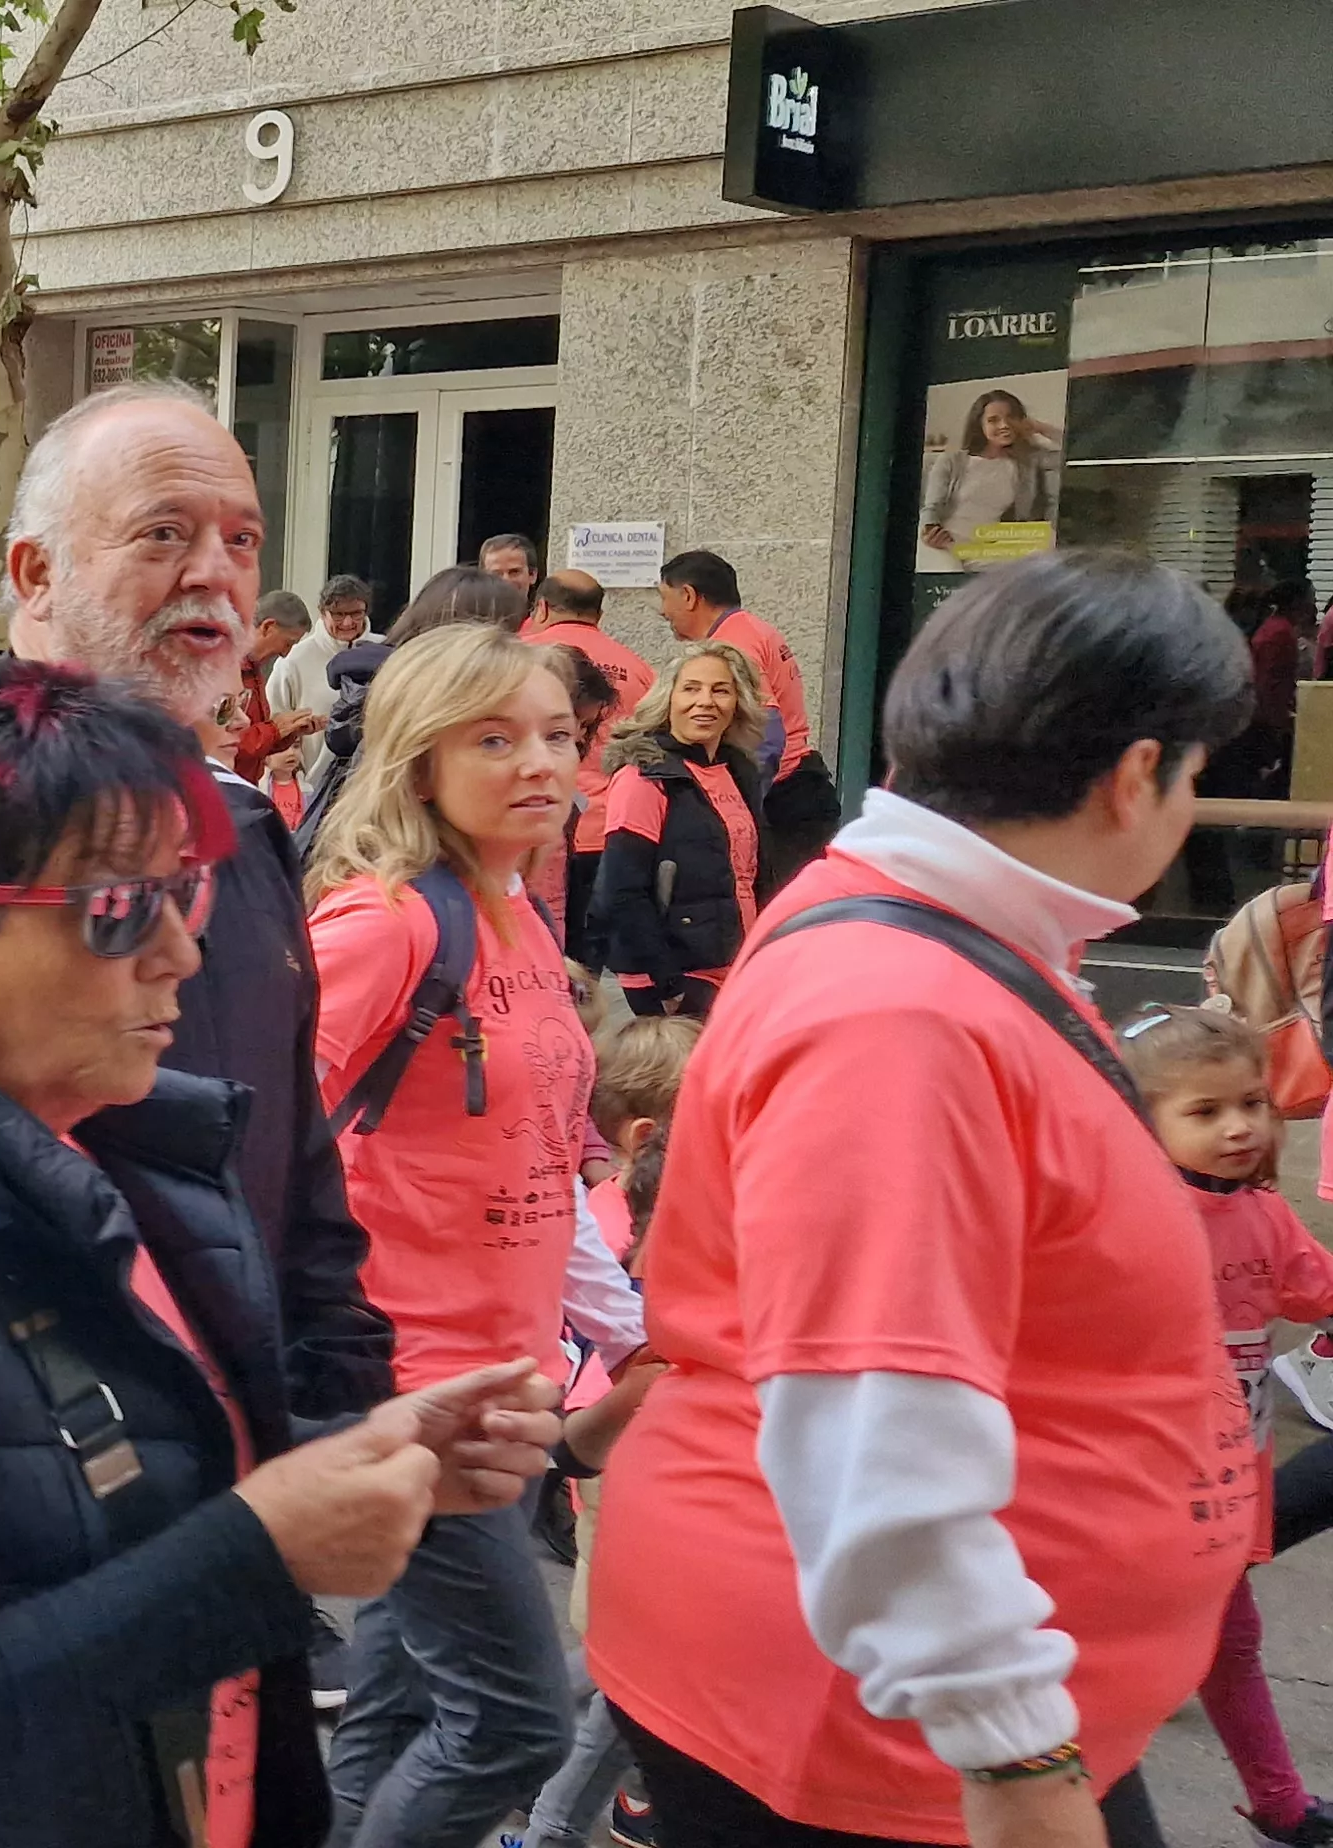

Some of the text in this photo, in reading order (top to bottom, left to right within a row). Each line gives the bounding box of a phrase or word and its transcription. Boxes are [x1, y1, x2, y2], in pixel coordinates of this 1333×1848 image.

[242, 110, 294, 203] 9
[948, 312, 1057, 339] LOARRE
[94, 332, 132, 349] OFICINA
[627, 532, 660, 543] DENTAL
